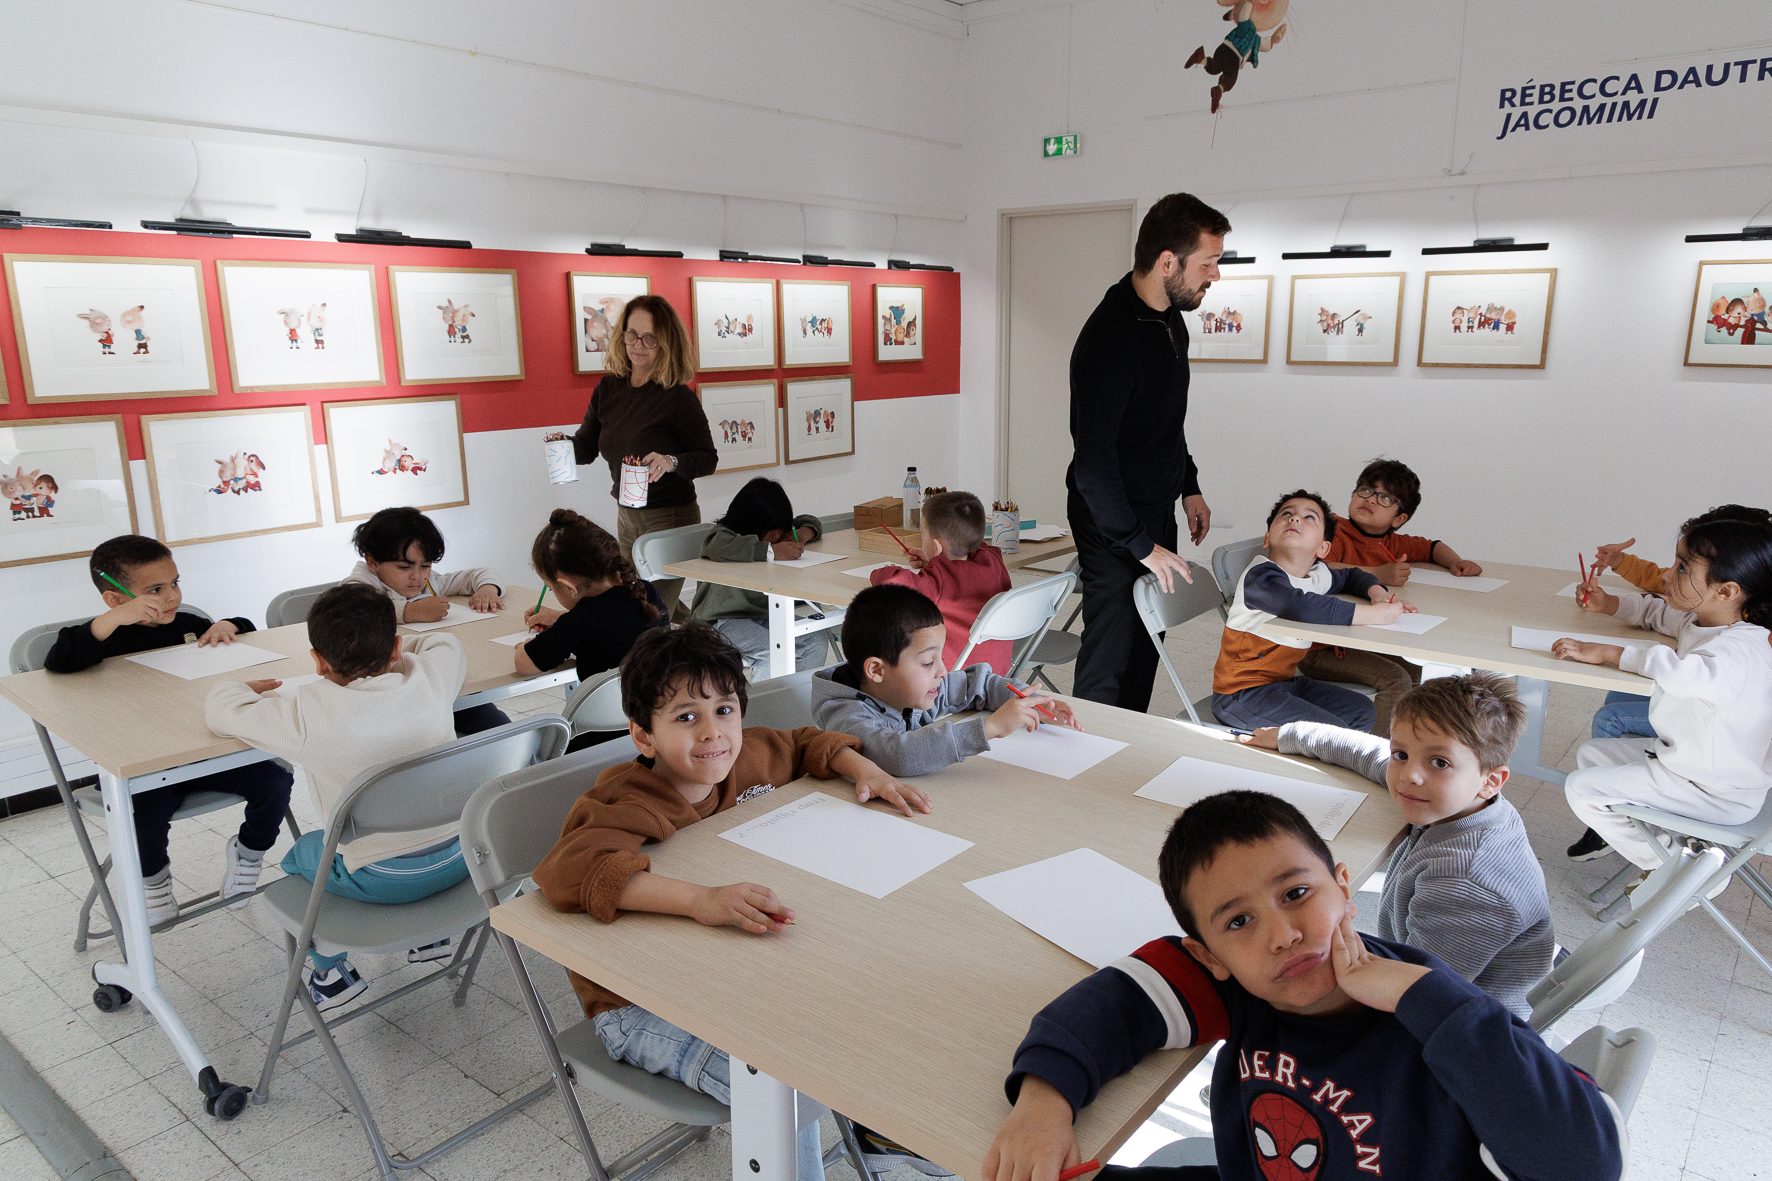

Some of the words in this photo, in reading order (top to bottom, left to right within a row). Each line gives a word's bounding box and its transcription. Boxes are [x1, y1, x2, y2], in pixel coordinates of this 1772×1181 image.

[1498, 78, 1645, 110] RÉBECCA
[1495, 97, 1660, 141] JACOMIMI
[797, 797, 829, 810] Trop
